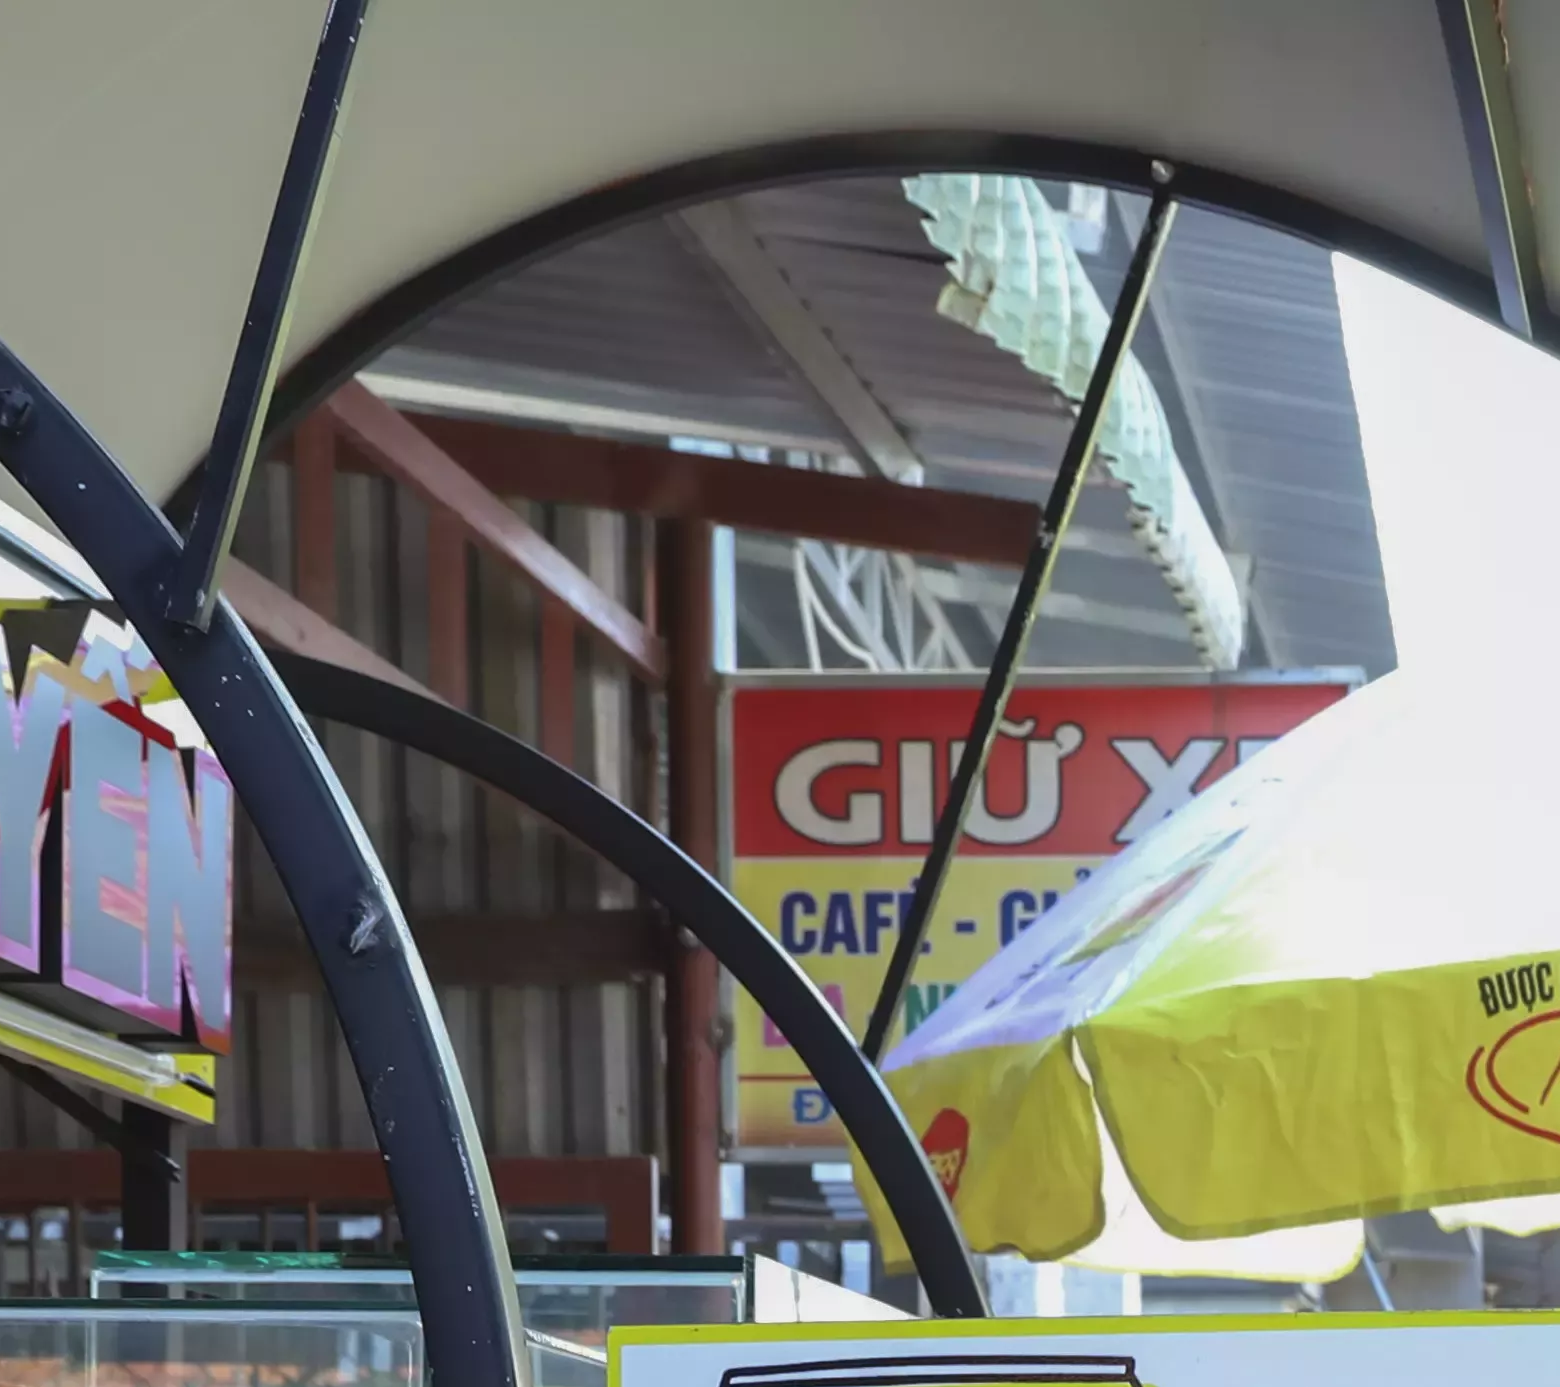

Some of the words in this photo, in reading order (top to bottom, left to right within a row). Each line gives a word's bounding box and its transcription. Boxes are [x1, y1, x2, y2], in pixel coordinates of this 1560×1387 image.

[773, 714, 1086, 848] GIỮ
[1110, 736, 1283, 846] X
[1478, 961, 1555, 1019] ĐƯỢC
